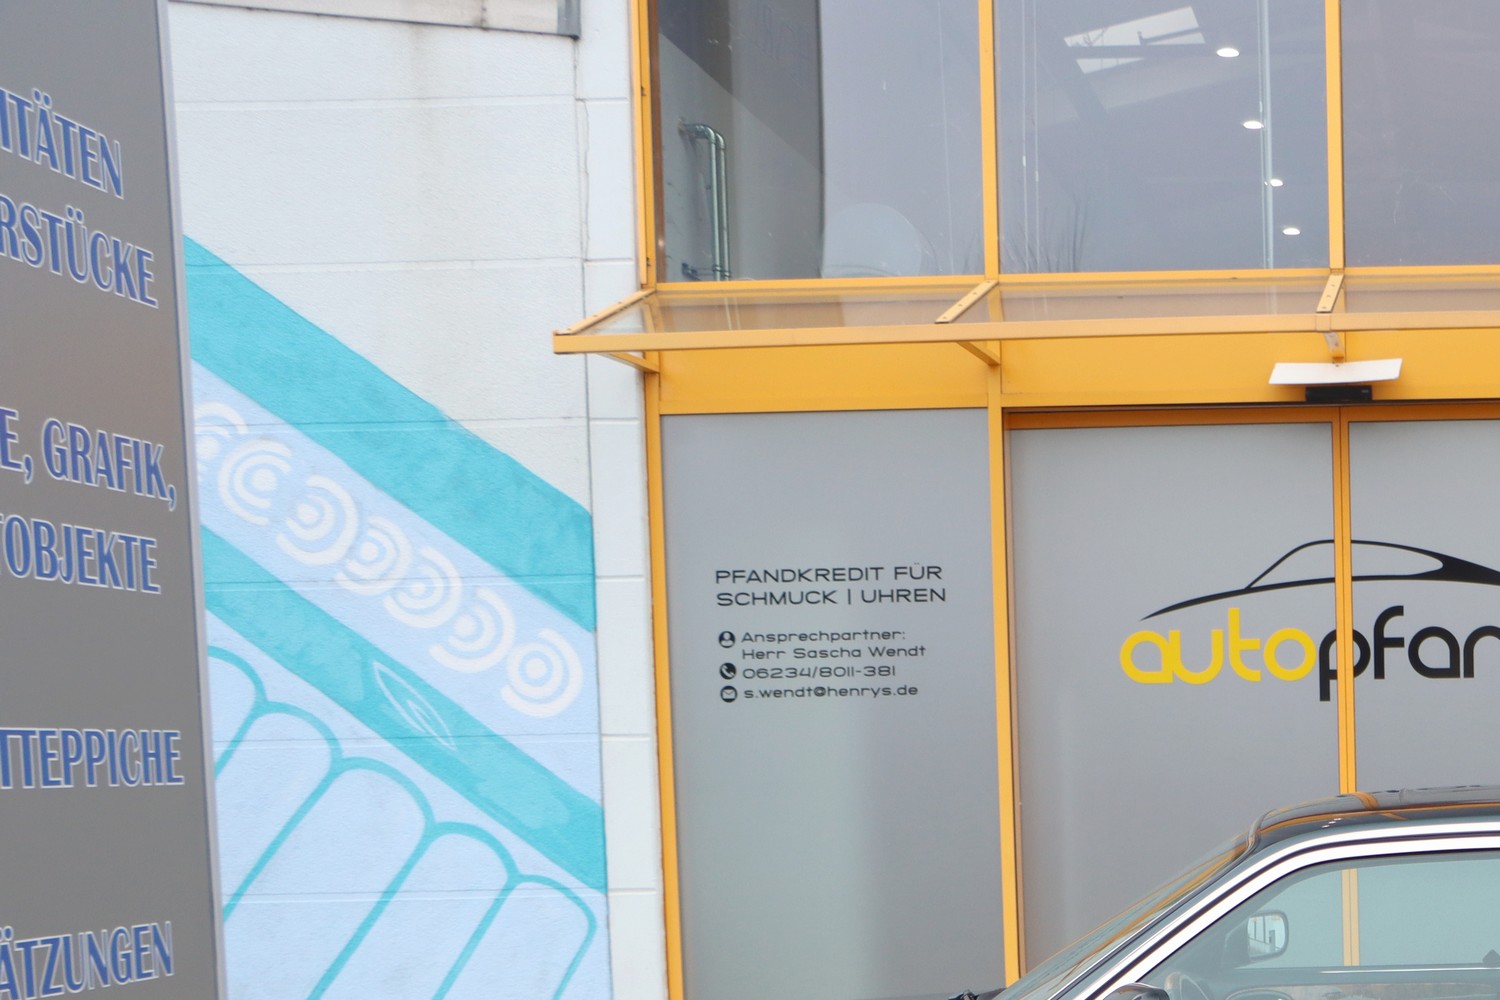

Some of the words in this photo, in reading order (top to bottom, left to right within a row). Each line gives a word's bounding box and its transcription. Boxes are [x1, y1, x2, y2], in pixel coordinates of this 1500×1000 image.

[41, 417, 177, 512] GRAFIK,
[0, 513, 161, 595] OBJEKTE
[715, 566, 884, 584] PFANDKREDIT
[894, 562, 943, 581] FÜR
[716, 590, 837, 606] SCHMUCK
[861, 588, 946, 603] UHREN
[741, 629, 906, 645] Ansprechpartner:
[742, 648, 787, 660] Herr
[793, 647, 861, 659] Sascha
[867, 645, 926, 657] Wendt
[742, 665, 896, 679] 06234/8011-381
[744, 684, 918, 699] s.wendt@henrys.de
